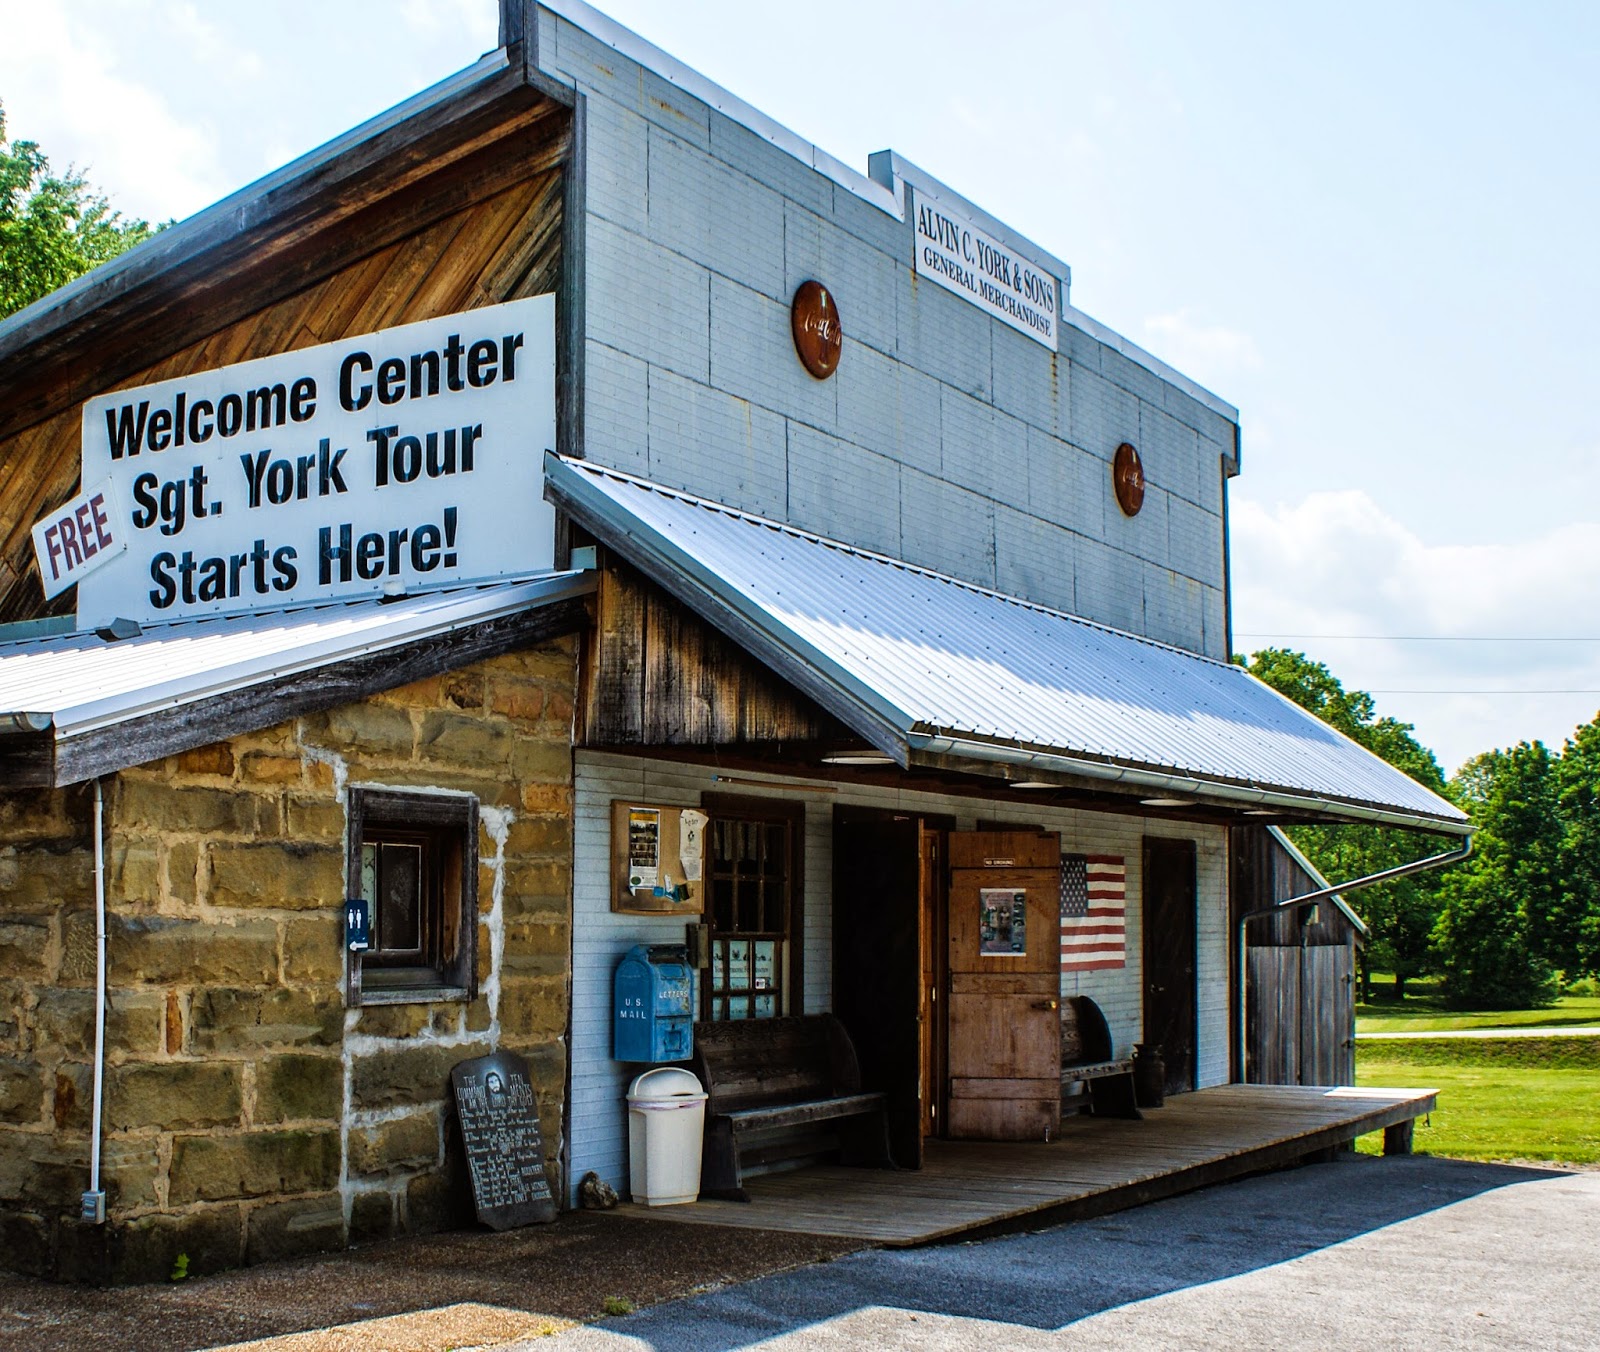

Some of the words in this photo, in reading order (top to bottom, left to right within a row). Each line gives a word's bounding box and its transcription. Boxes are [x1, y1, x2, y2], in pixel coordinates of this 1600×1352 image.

[918, 203, 959, 256] ALVIN
[962, 231, 975, 265] C.
[976, 238, 1011, 287] YORK
[1013, 262, 1022, 294] &
[1024, 269, 1054, 313] SONS
[924, 247, 977, 293] GENERAL
[979, 279, 1051, 337] MERCHANDISE
[106, 376, 317, 460] Welcome
[338, 331, 524, 412] Center
[131, 465, 222, 537] Sgt.
[240, 437, 349, 509] York
[367, 423, 483, 488] Tour
[43, 492, 113, 581] FREE
[149, 538, 298, 609] Starts
[318, 506, 458, 585] Here!
[620, 1010, 647, 1020] MAIL
[658, 990, 688, 999] LETTERS
[457, 1085, 486, 1100] COMMAND
[510, 1084, 532, 1097] MENTS
[463, 1075, 476, 1086] THE
[510, 1074, 523, 1086] TEN
